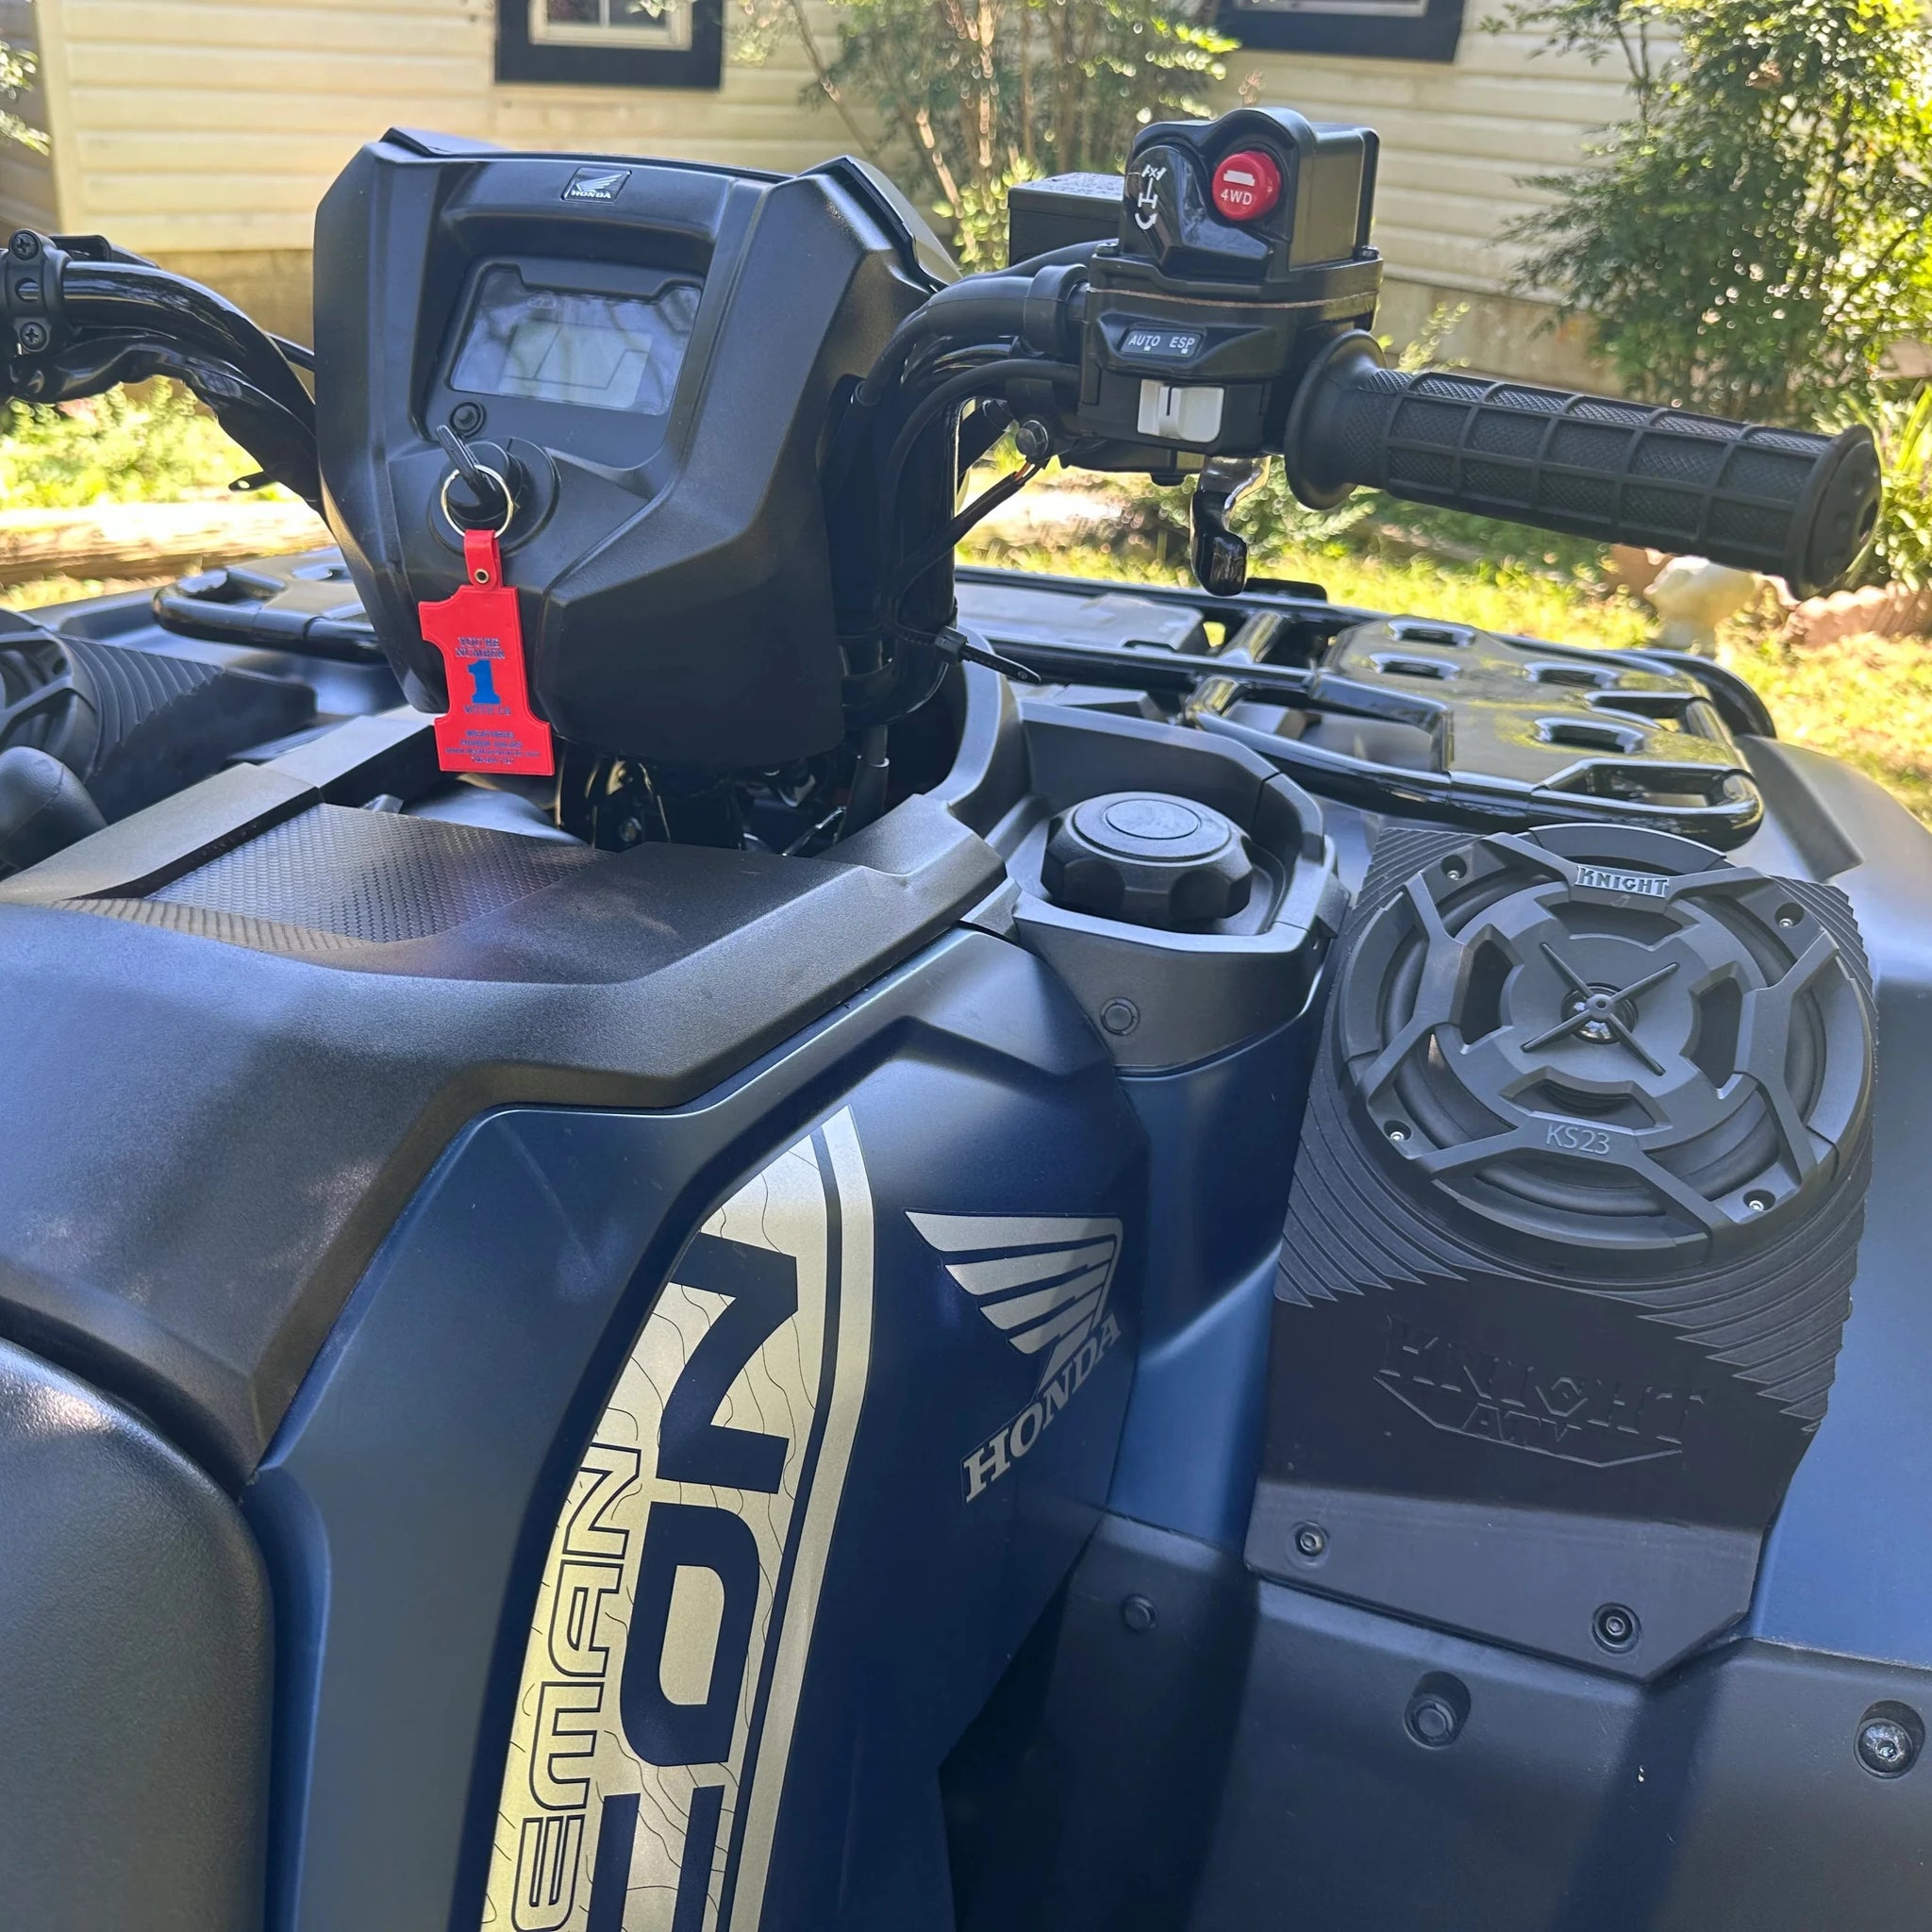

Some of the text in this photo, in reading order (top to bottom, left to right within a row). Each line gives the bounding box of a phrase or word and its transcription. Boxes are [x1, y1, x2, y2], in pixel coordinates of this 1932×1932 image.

[571, 190, 612, 199] HONDA
[1221, 188, 1253, 206] 4WD
[1128, 334, 1195, 350] AUTO ESP
[467, 659, 501, 705] 1
[1575, 865, 1669, 898] KNIGHT
[1546, 1124, 1610, 1155] KS23
[963, 1309, 1123, 1504] HONDA
